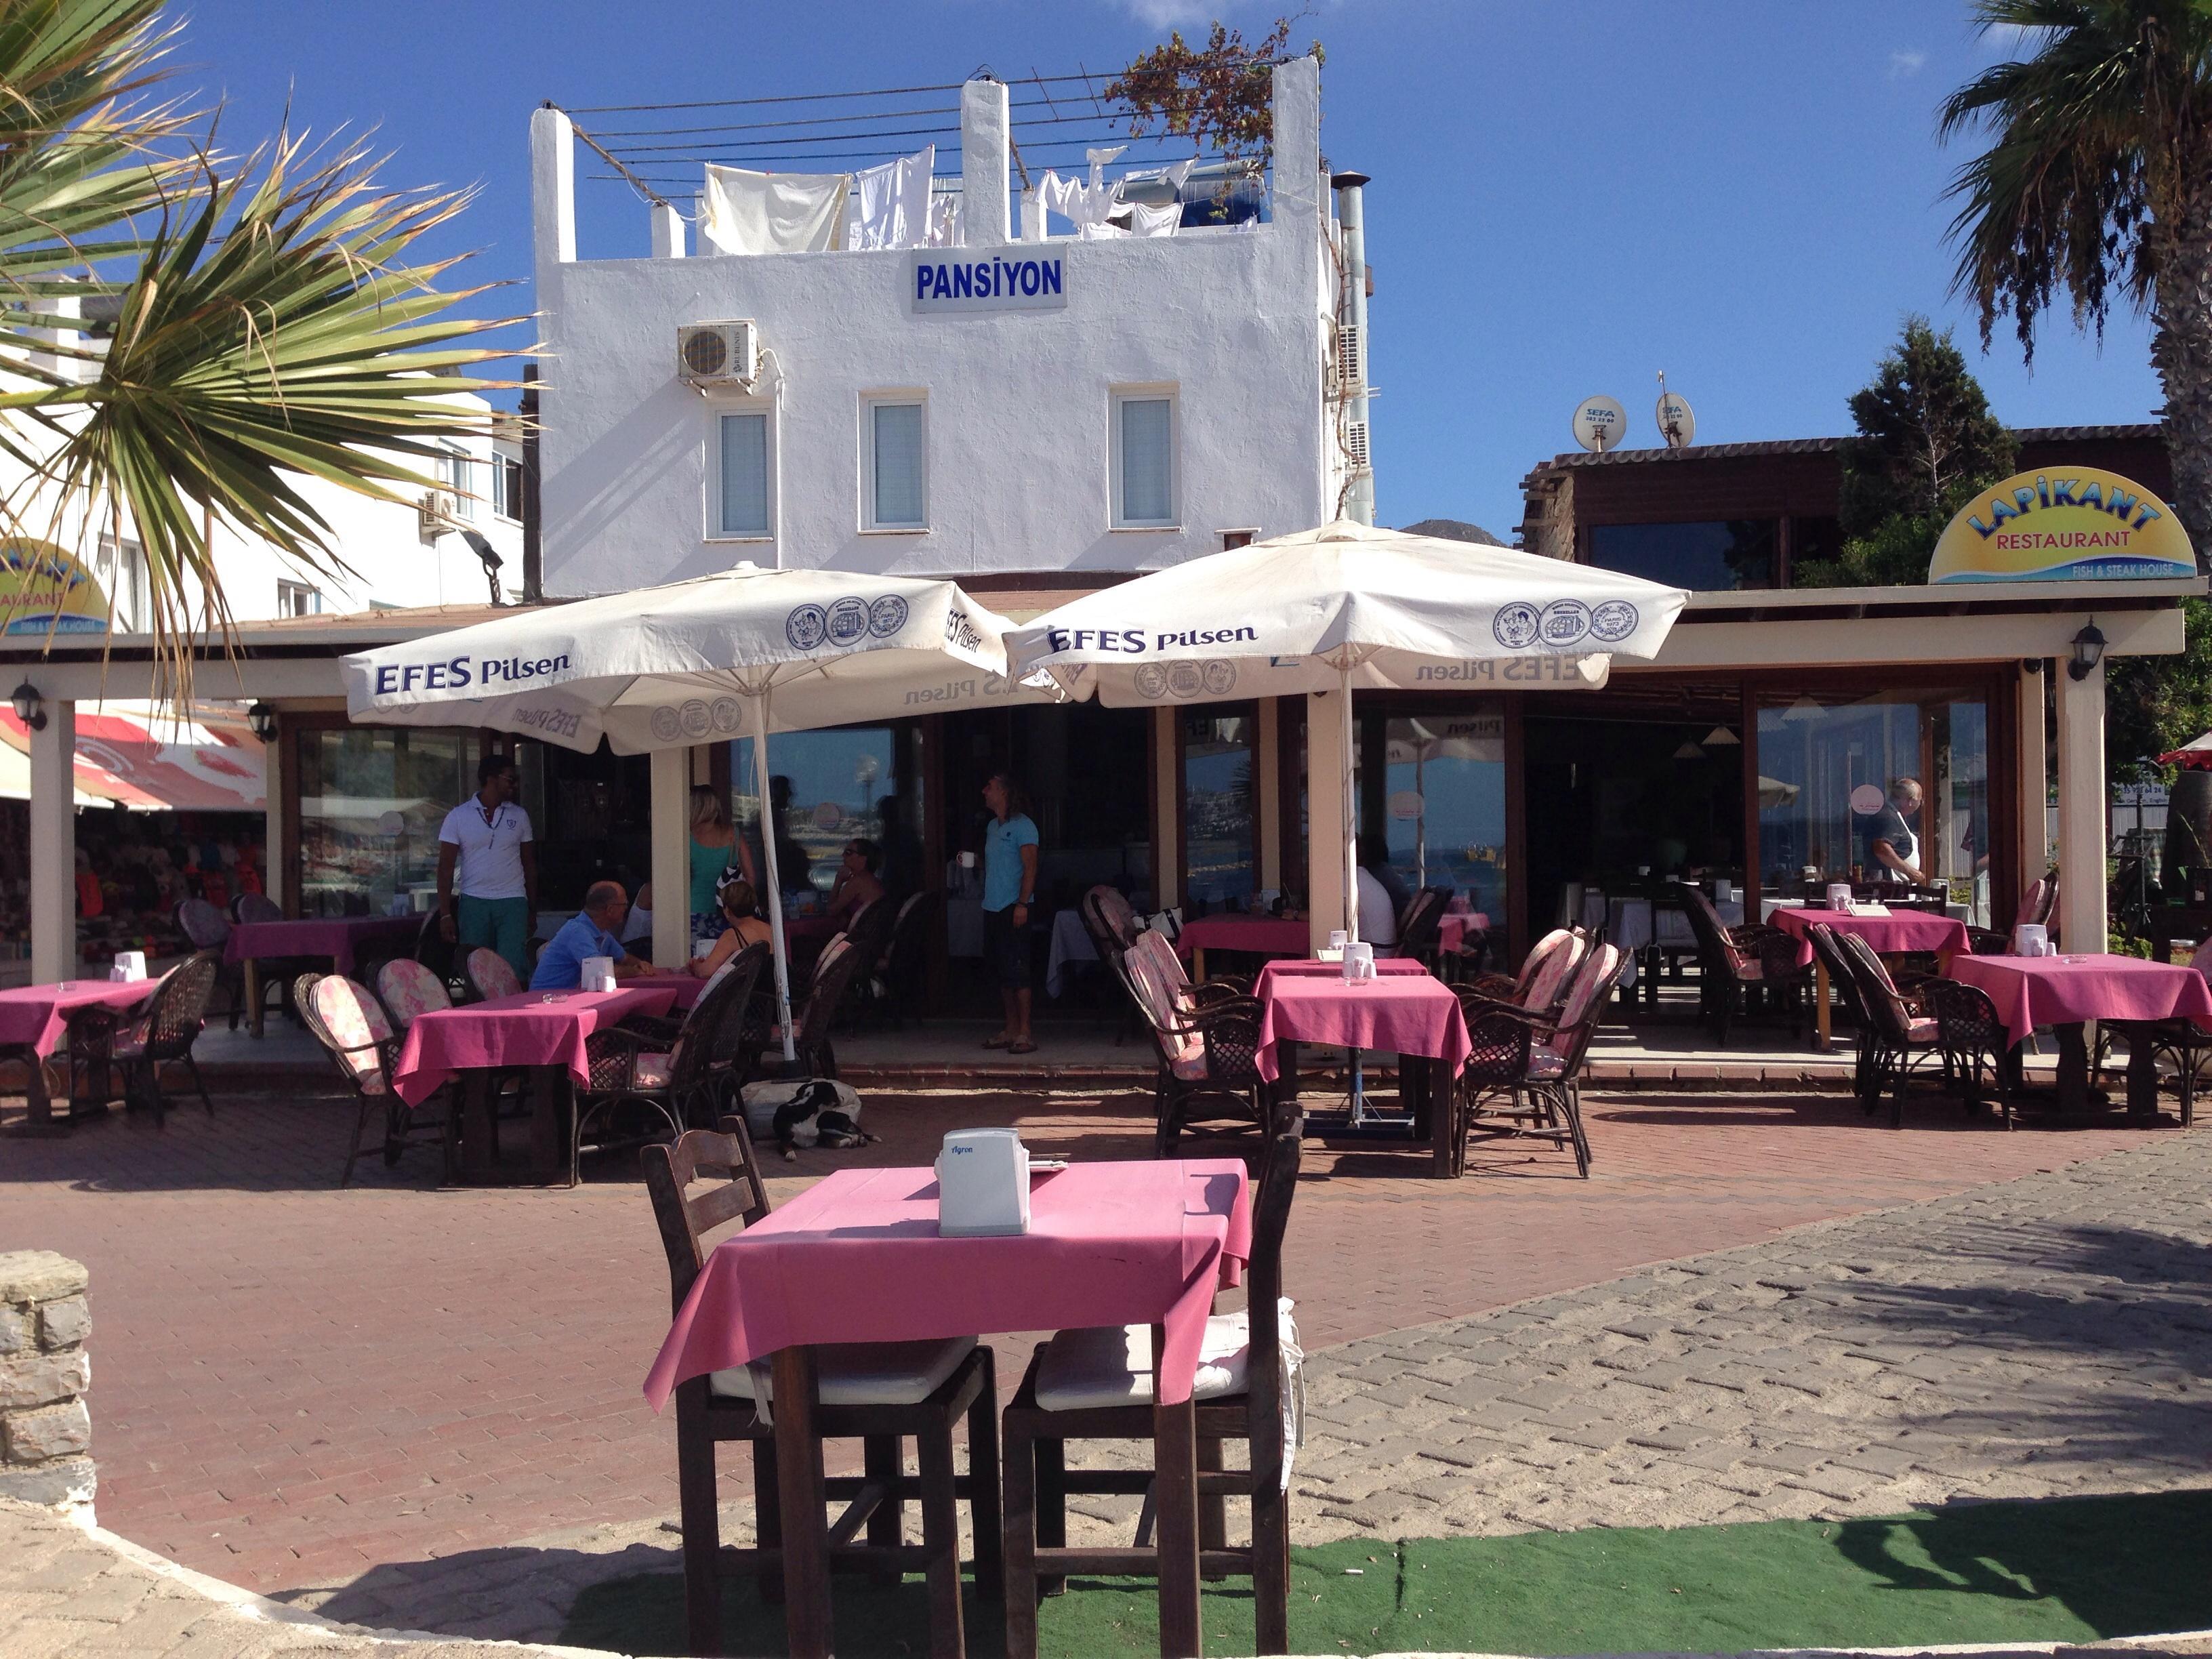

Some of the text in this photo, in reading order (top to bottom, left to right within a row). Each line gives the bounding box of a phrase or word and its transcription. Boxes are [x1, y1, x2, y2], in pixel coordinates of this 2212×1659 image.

[918, 257, 1061, 299] PANSİYON
[1586, 409, 1614, 417] SEFA
[1996, 531, 2131, 550] RESTAURANT
[2072, 564, 2174, 577] FISH & STEAK HOUSE
[1047, 626, 1258, 654] EFES Pilsen
[375, 655, 570, 695] EFES Pilsen
